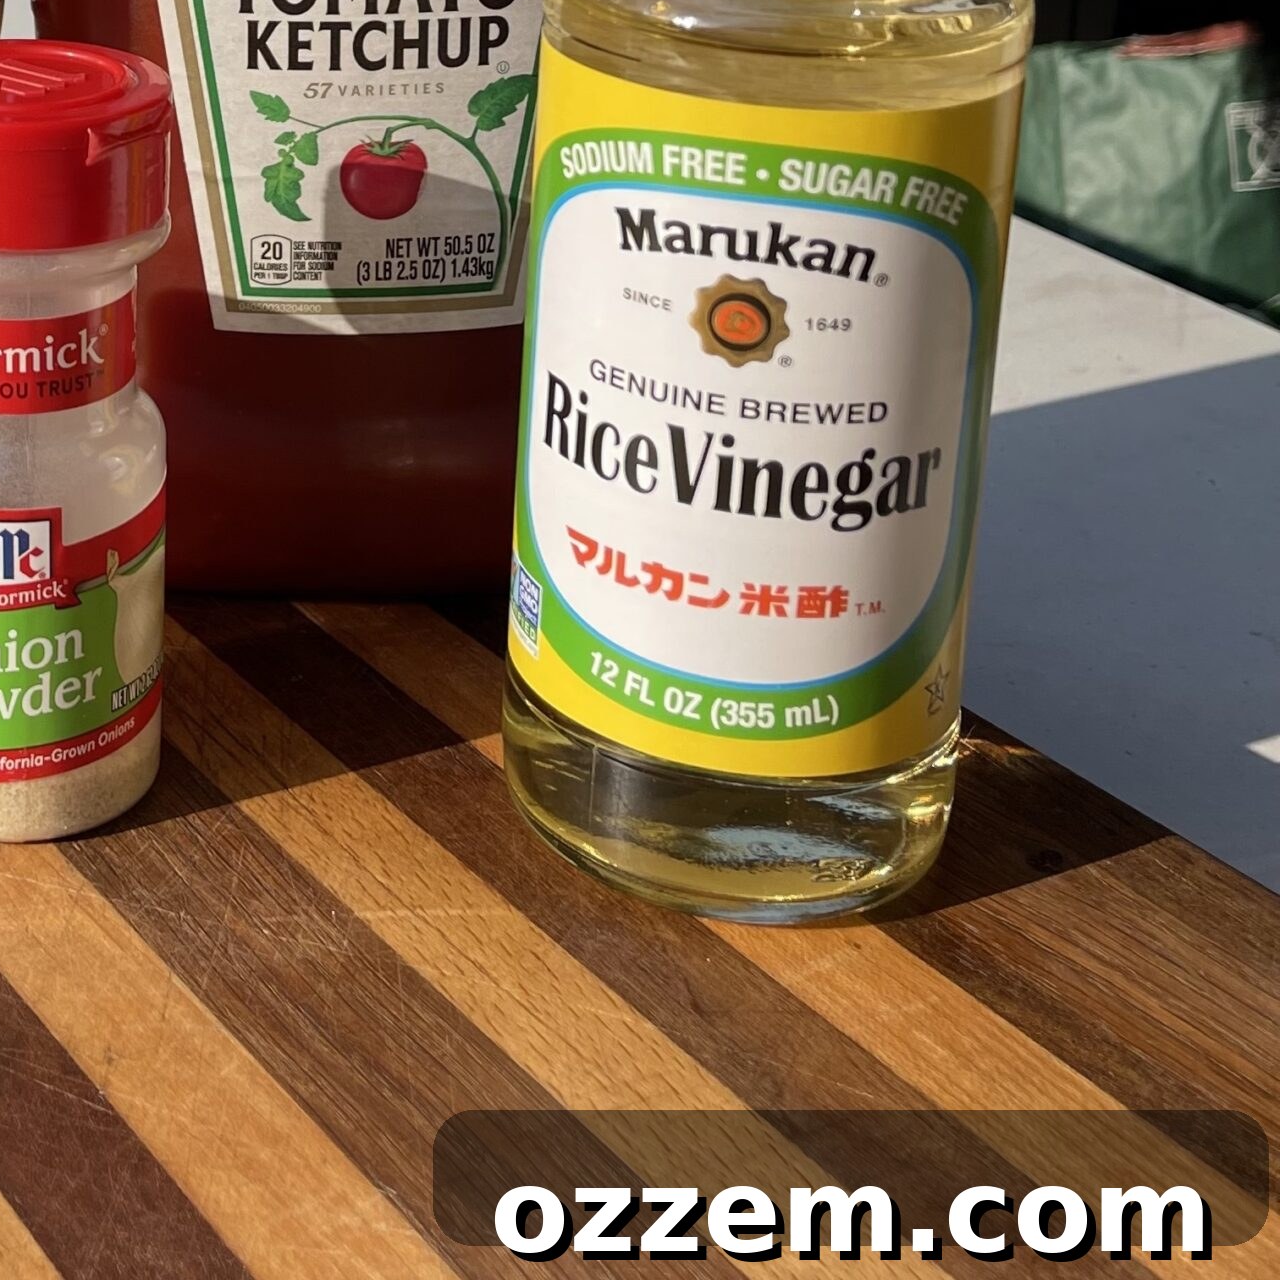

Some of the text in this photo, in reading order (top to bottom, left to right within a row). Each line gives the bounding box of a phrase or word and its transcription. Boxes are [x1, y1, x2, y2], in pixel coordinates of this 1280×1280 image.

[246, 15, 510, 72] KETCHUP
[303, 82, 445, 99] 57 VARIETIES
[560, 140, 969, 227] SODIUM FREE SUGAR FREE
[260, 241, 283, 260] 20
[292, 241, 342, 251] SEE NUTRITION
[292, 251, 338, 261] INFORMATION
[385, 233, 496, 259] NET WT 50.5 OZ
[614, 206, 877, 283] Marukan
[253, 262, 288, 271] CALORIES
[292, 261, 335, 271] FOR SODIUM
[292, 271, 322, 281] CONTENT
[356, 256, 494, 286] (3 LB 2.5 OZ) 1.43kg
[622, 286, 673, 311] SINCE
[804, 317, 853, 332] 1649
[36, 372, 95, 399] TRUST
[589, 358, 889, 424] GENUINE BREWED
[543, 370, 943, 533] Rice Vinegar
[565, 523, 850, 619] マルカン 米酢
[111, 686, 128, 712] NET
[591, 651, 840, 730] 12 FL OZ (355 mL)
[98, 717, 136, 747] Onions
